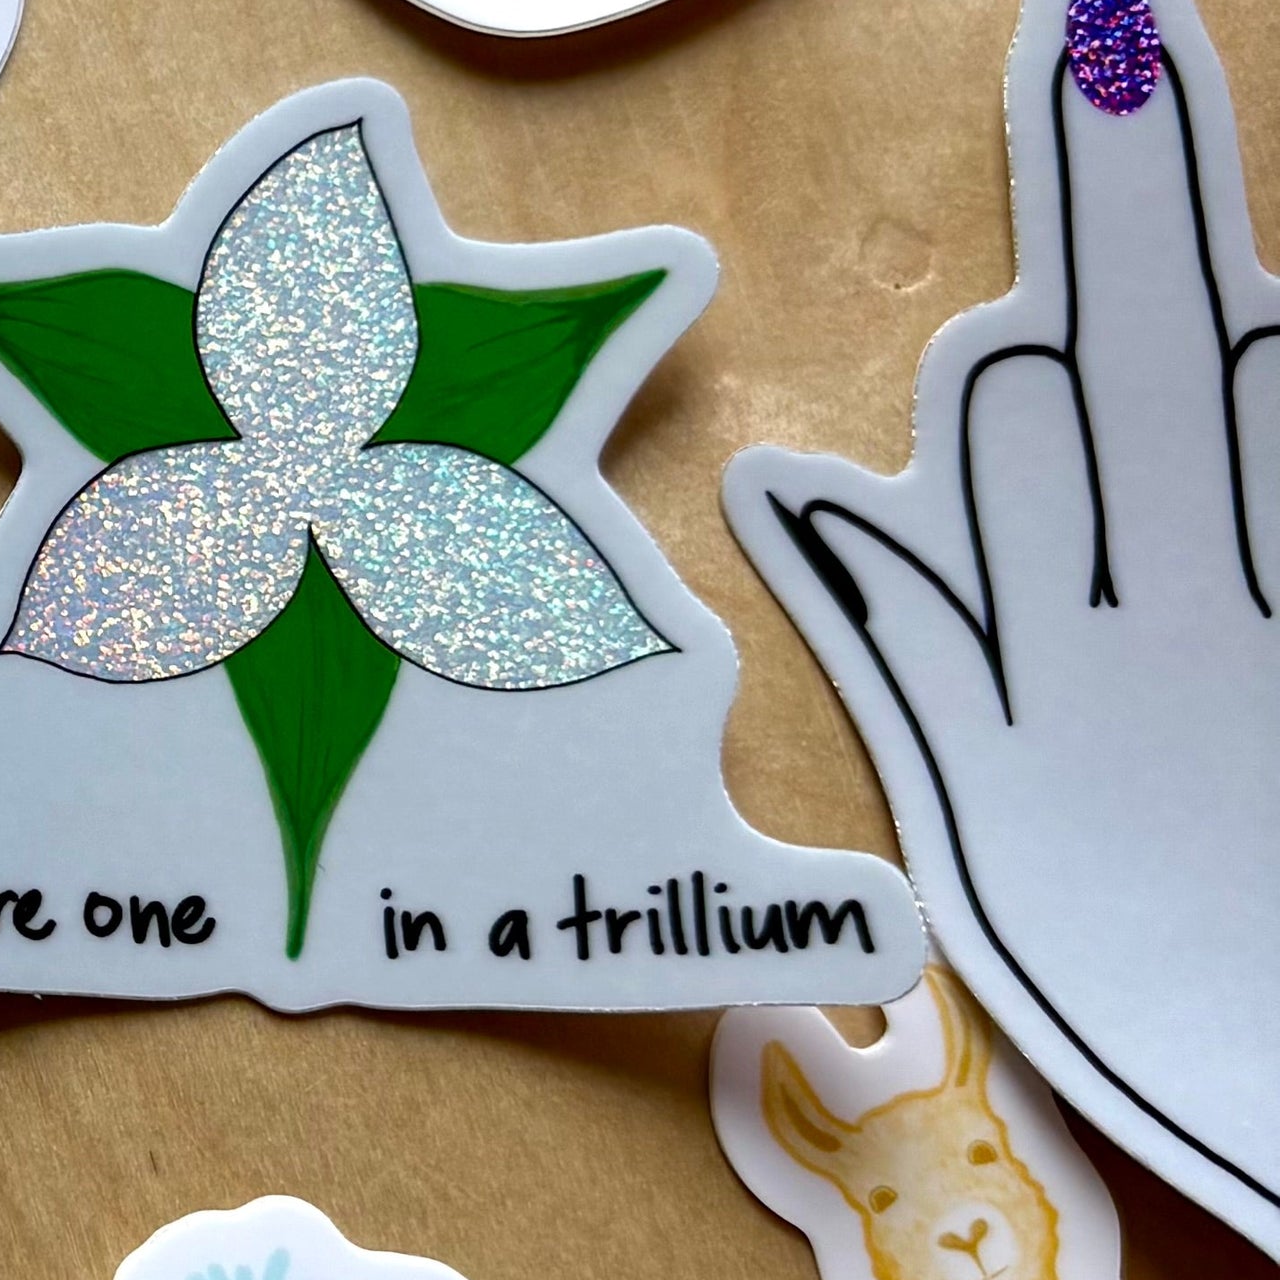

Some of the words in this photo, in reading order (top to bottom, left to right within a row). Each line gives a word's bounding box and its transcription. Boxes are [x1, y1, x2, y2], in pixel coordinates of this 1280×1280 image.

[83, 891, 217, 948] one
[379, 887, 449, 961] in
[488, 908, 533, 962] a
[559, 869, 878, 962] trillium
